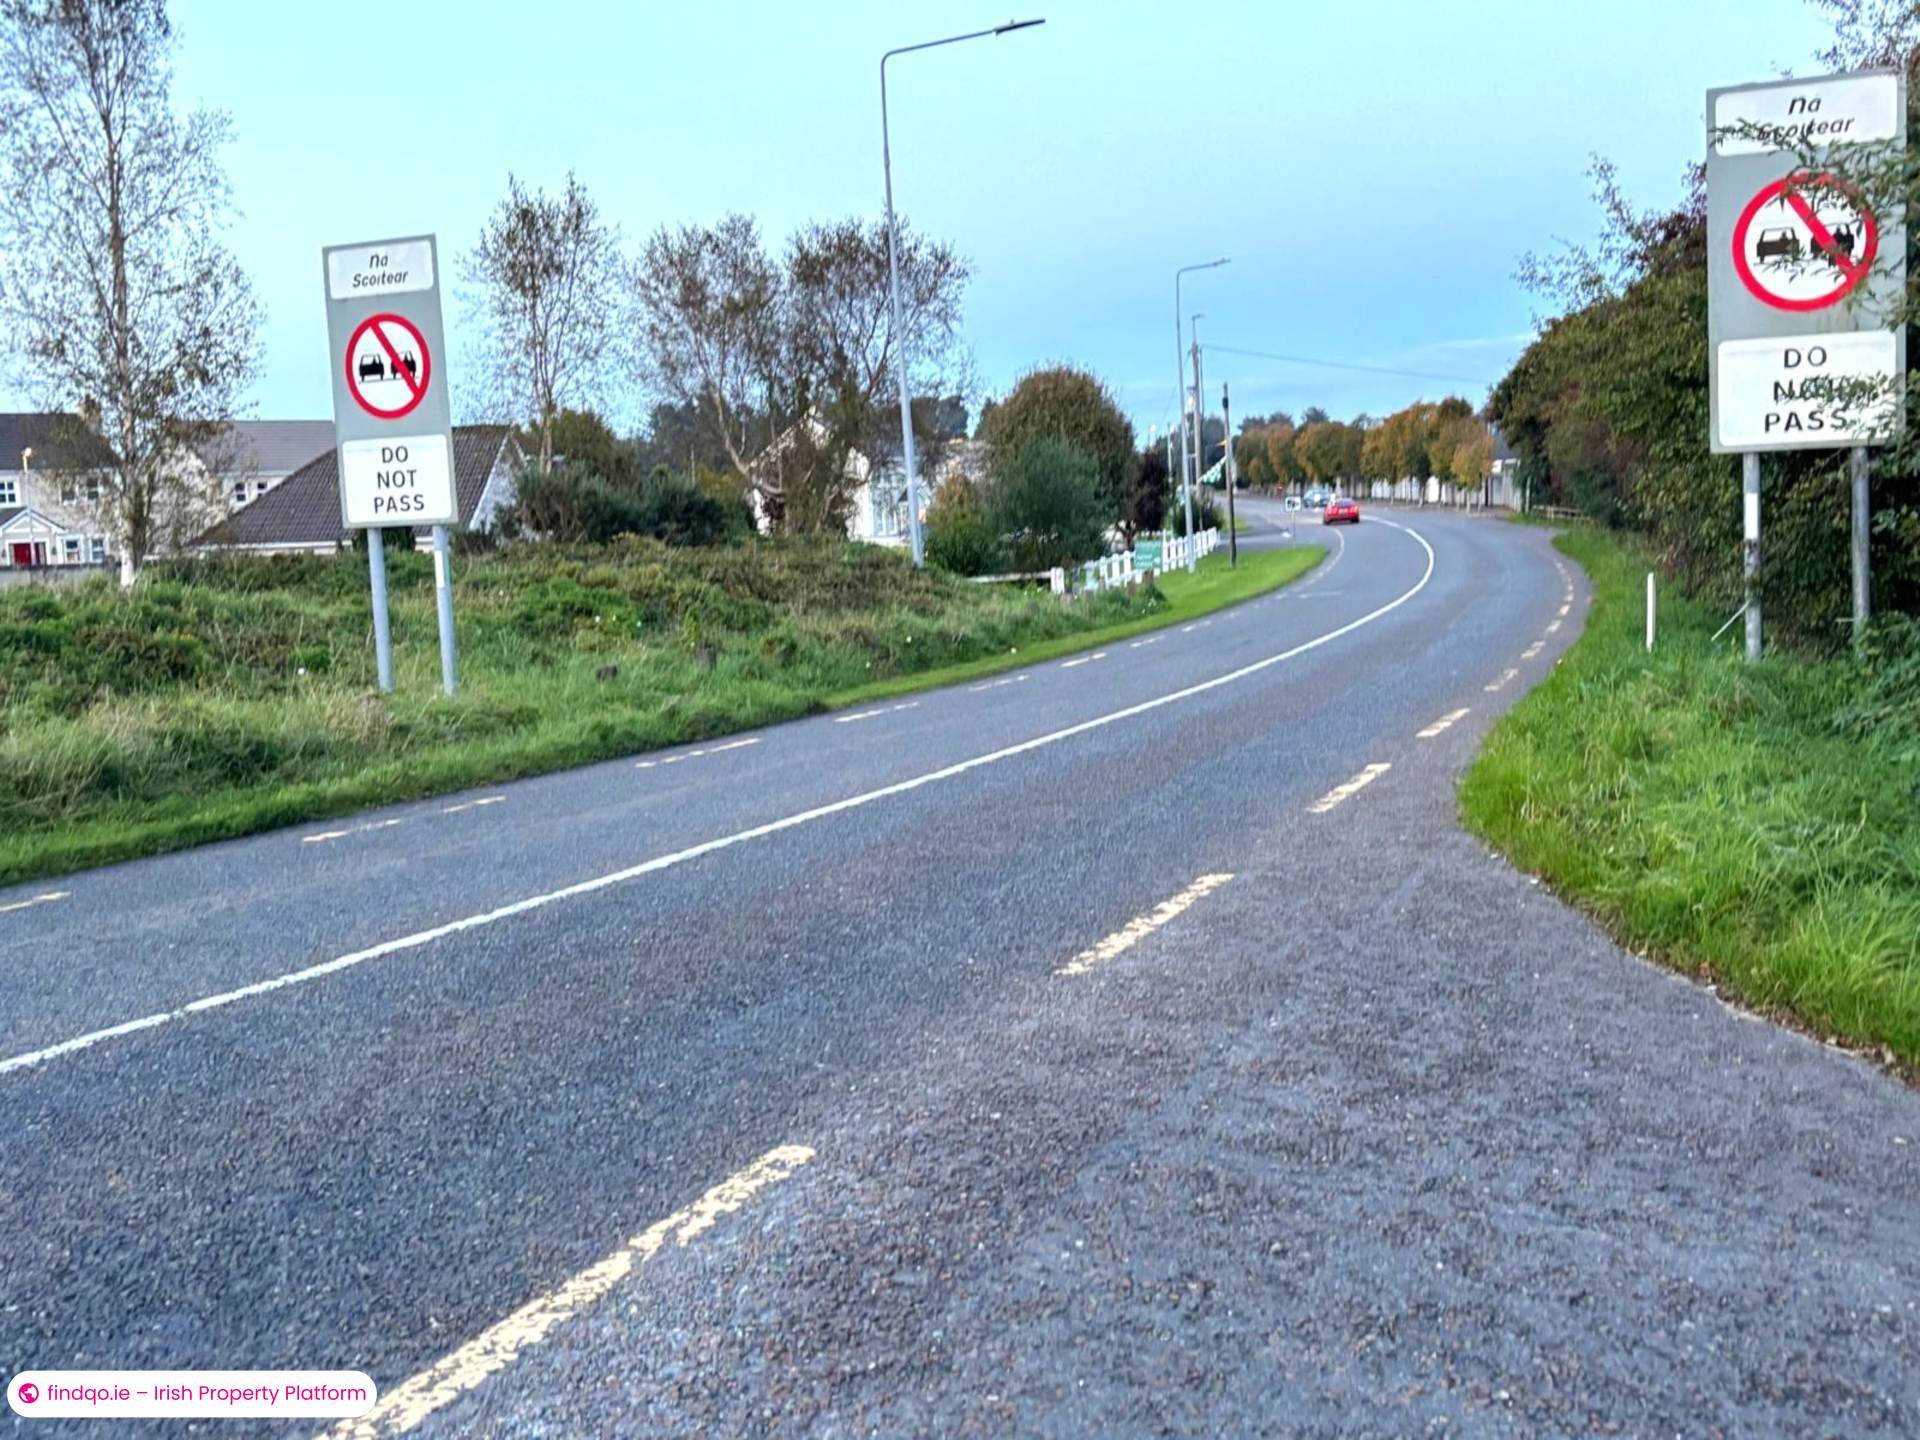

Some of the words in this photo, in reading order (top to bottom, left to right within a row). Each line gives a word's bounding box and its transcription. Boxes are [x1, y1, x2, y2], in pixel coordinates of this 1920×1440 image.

[1783, 346, 1828, 369] DO
[1764, 408, 1848, 433] PASS
[381, 445, 409, 464] DO
[376, 469, 418, 489] NOT
[373, 494, 425, 514] PASS
